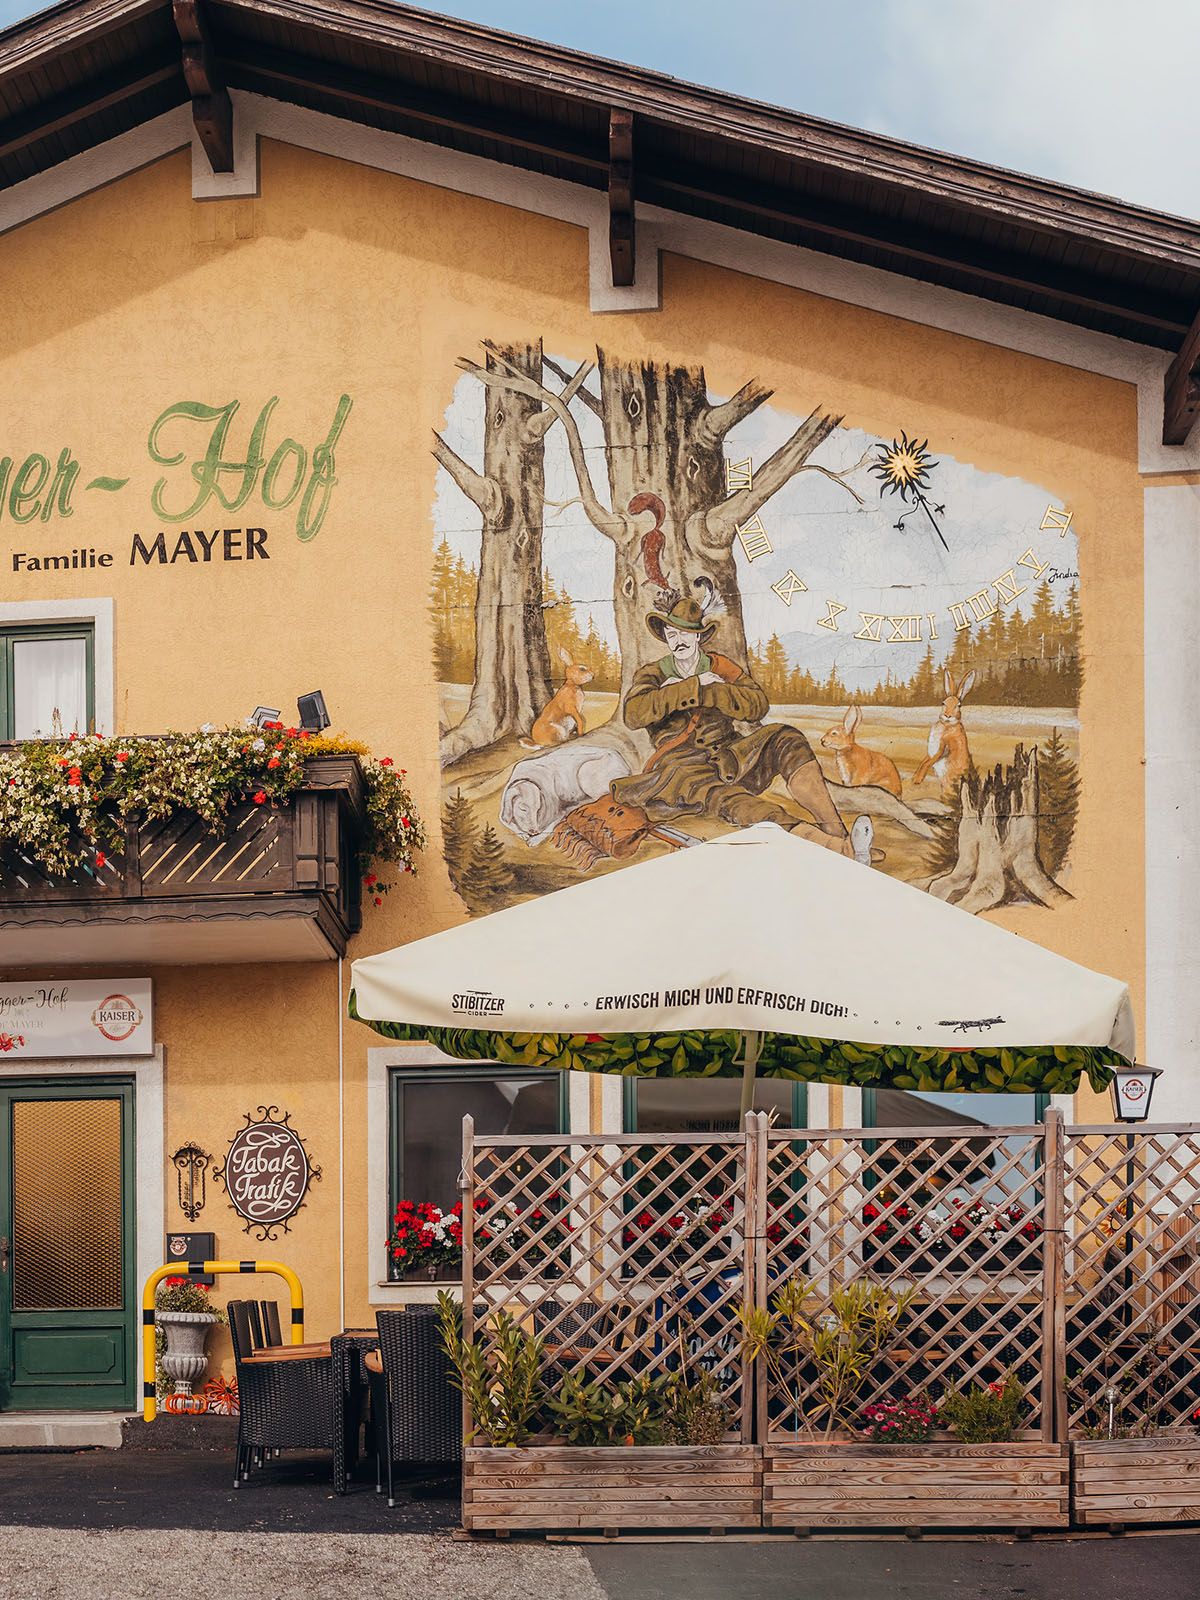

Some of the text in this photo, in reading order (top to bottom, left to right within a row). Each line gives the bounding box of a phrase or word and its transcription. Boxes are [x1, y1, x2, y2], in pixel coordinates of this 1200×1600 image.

[12, 526, 271, 573] Familie MAYER
[100, 1011, 135, 1022] KAISER
[451, 993, 505, 1012] STIBITZER
[595, 987, 849, 1018] ERWISCH MICH UND ERFRISCH DICH!
[232, 1145, 301, 1173] Tabak
[235, 1172, 299, 1201] Trafik
